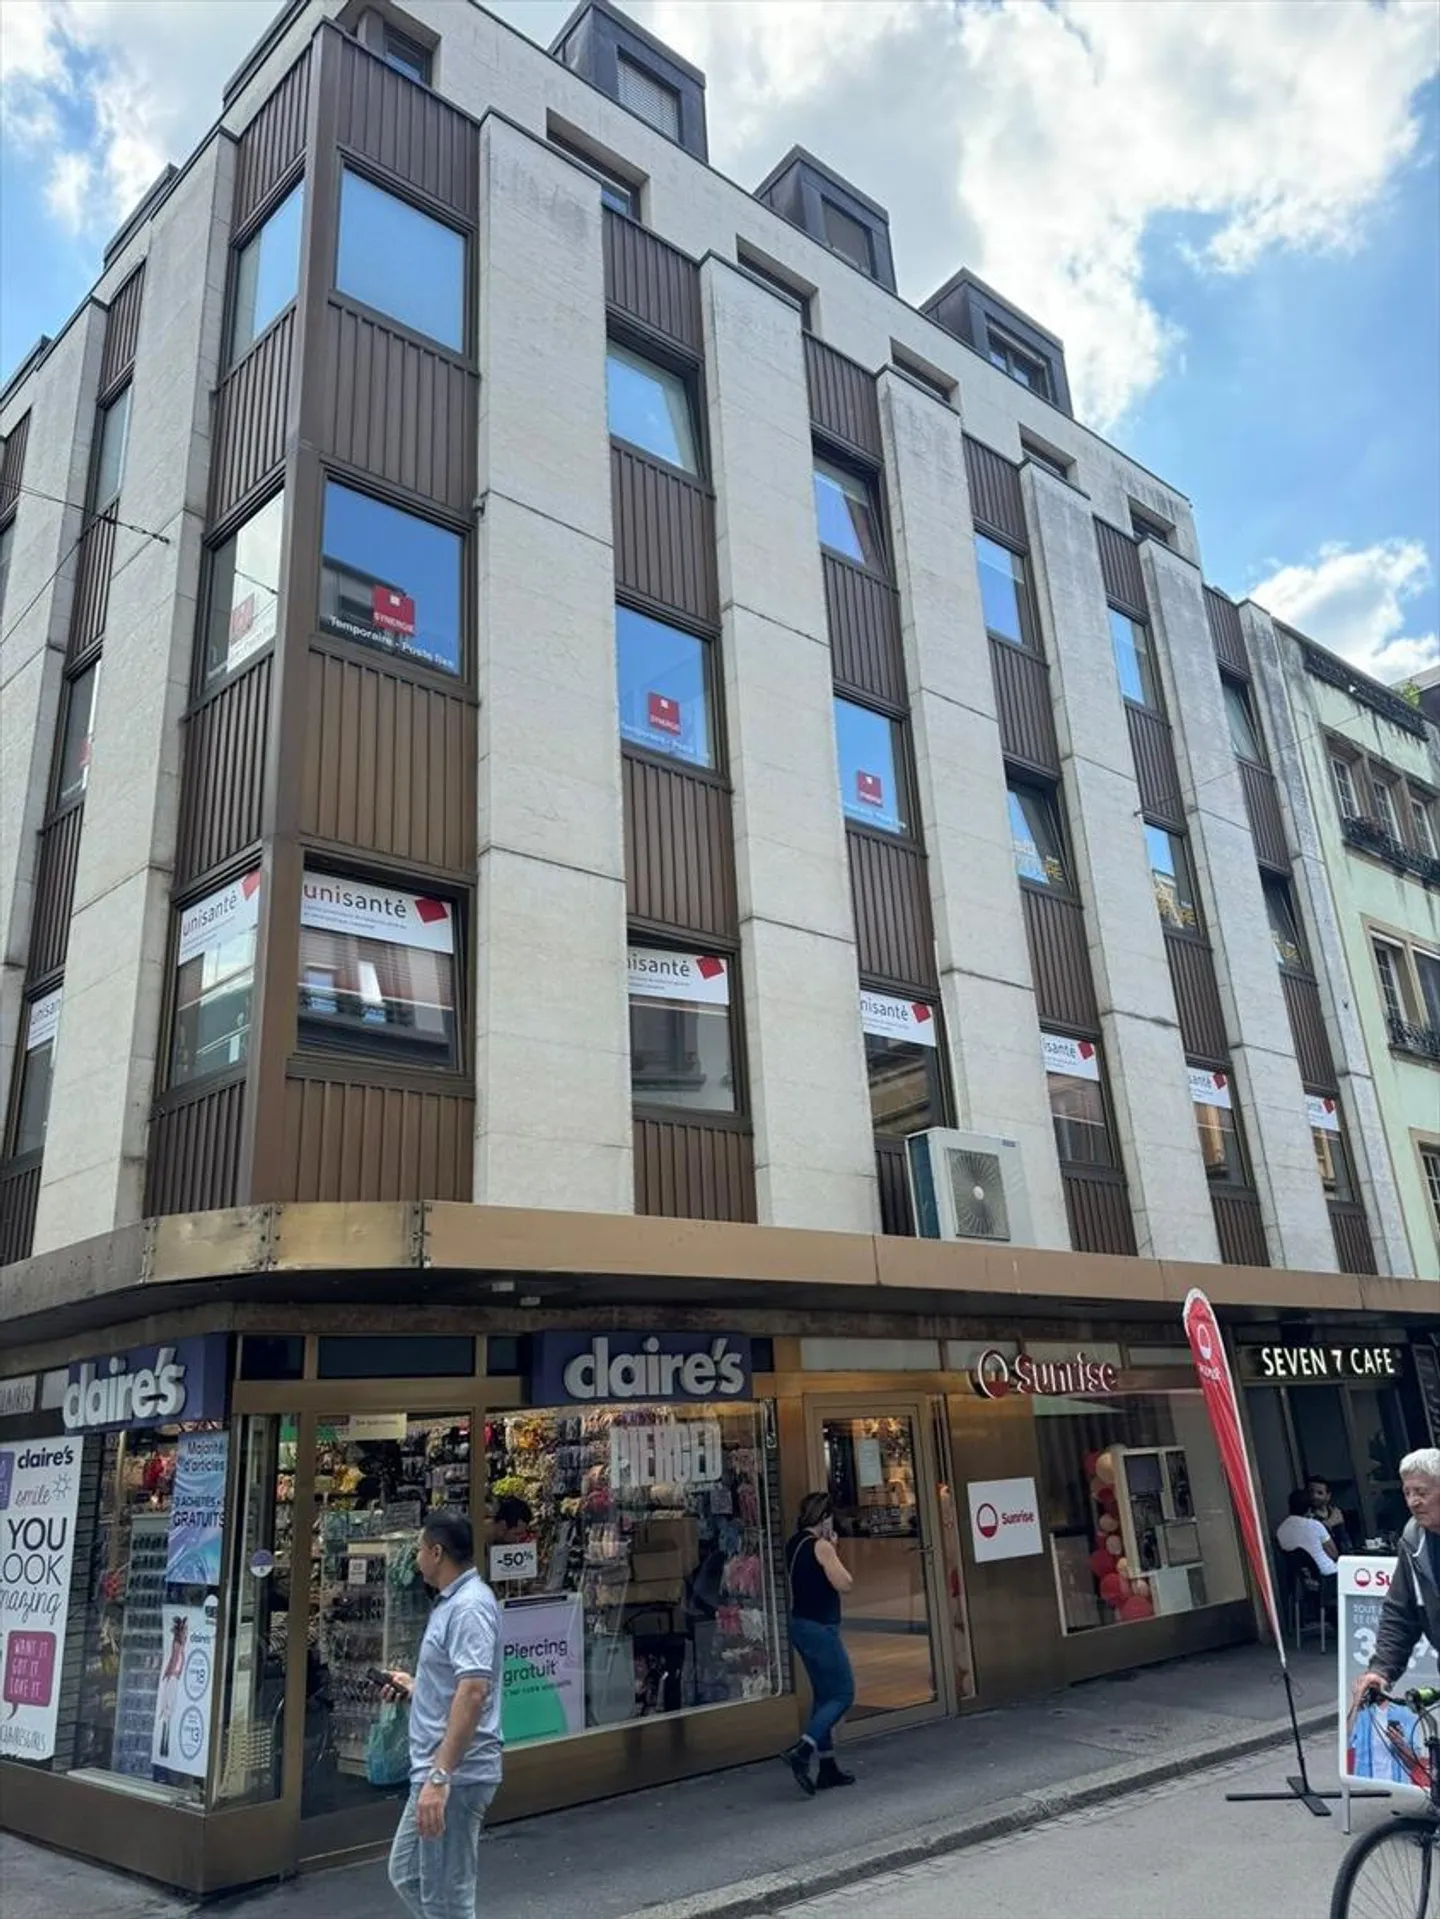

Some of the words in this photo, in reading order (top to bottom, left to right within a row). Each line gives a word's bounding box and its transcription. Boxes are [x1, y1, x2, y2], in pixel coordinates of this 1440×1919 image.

[183, 889, 237, 937] unisanté
[303, 884, 407, 919] unisanté
[562, 1337, 745, 1399] claire's
[1014, 1351, 1118, 1394] Sunrise
[1261, 1347, 1327, 1376] SEVEN
[1330, 1349, 1342, 1373] 7
[1350, 1348, 1395, 1374] CAFE
[62, 1347, 186, 1429] claire's
[17, 1445, 74, 1469] claire's
[7, 1516, 68, 1551] YOU
[1001, 1509, 1034, 1525] Sunrise
[0, 1553, 64, 1586] OOK
[503, 1638, 568, 1660] Piercing
[503, 1662, 556, 1687] gratuit
